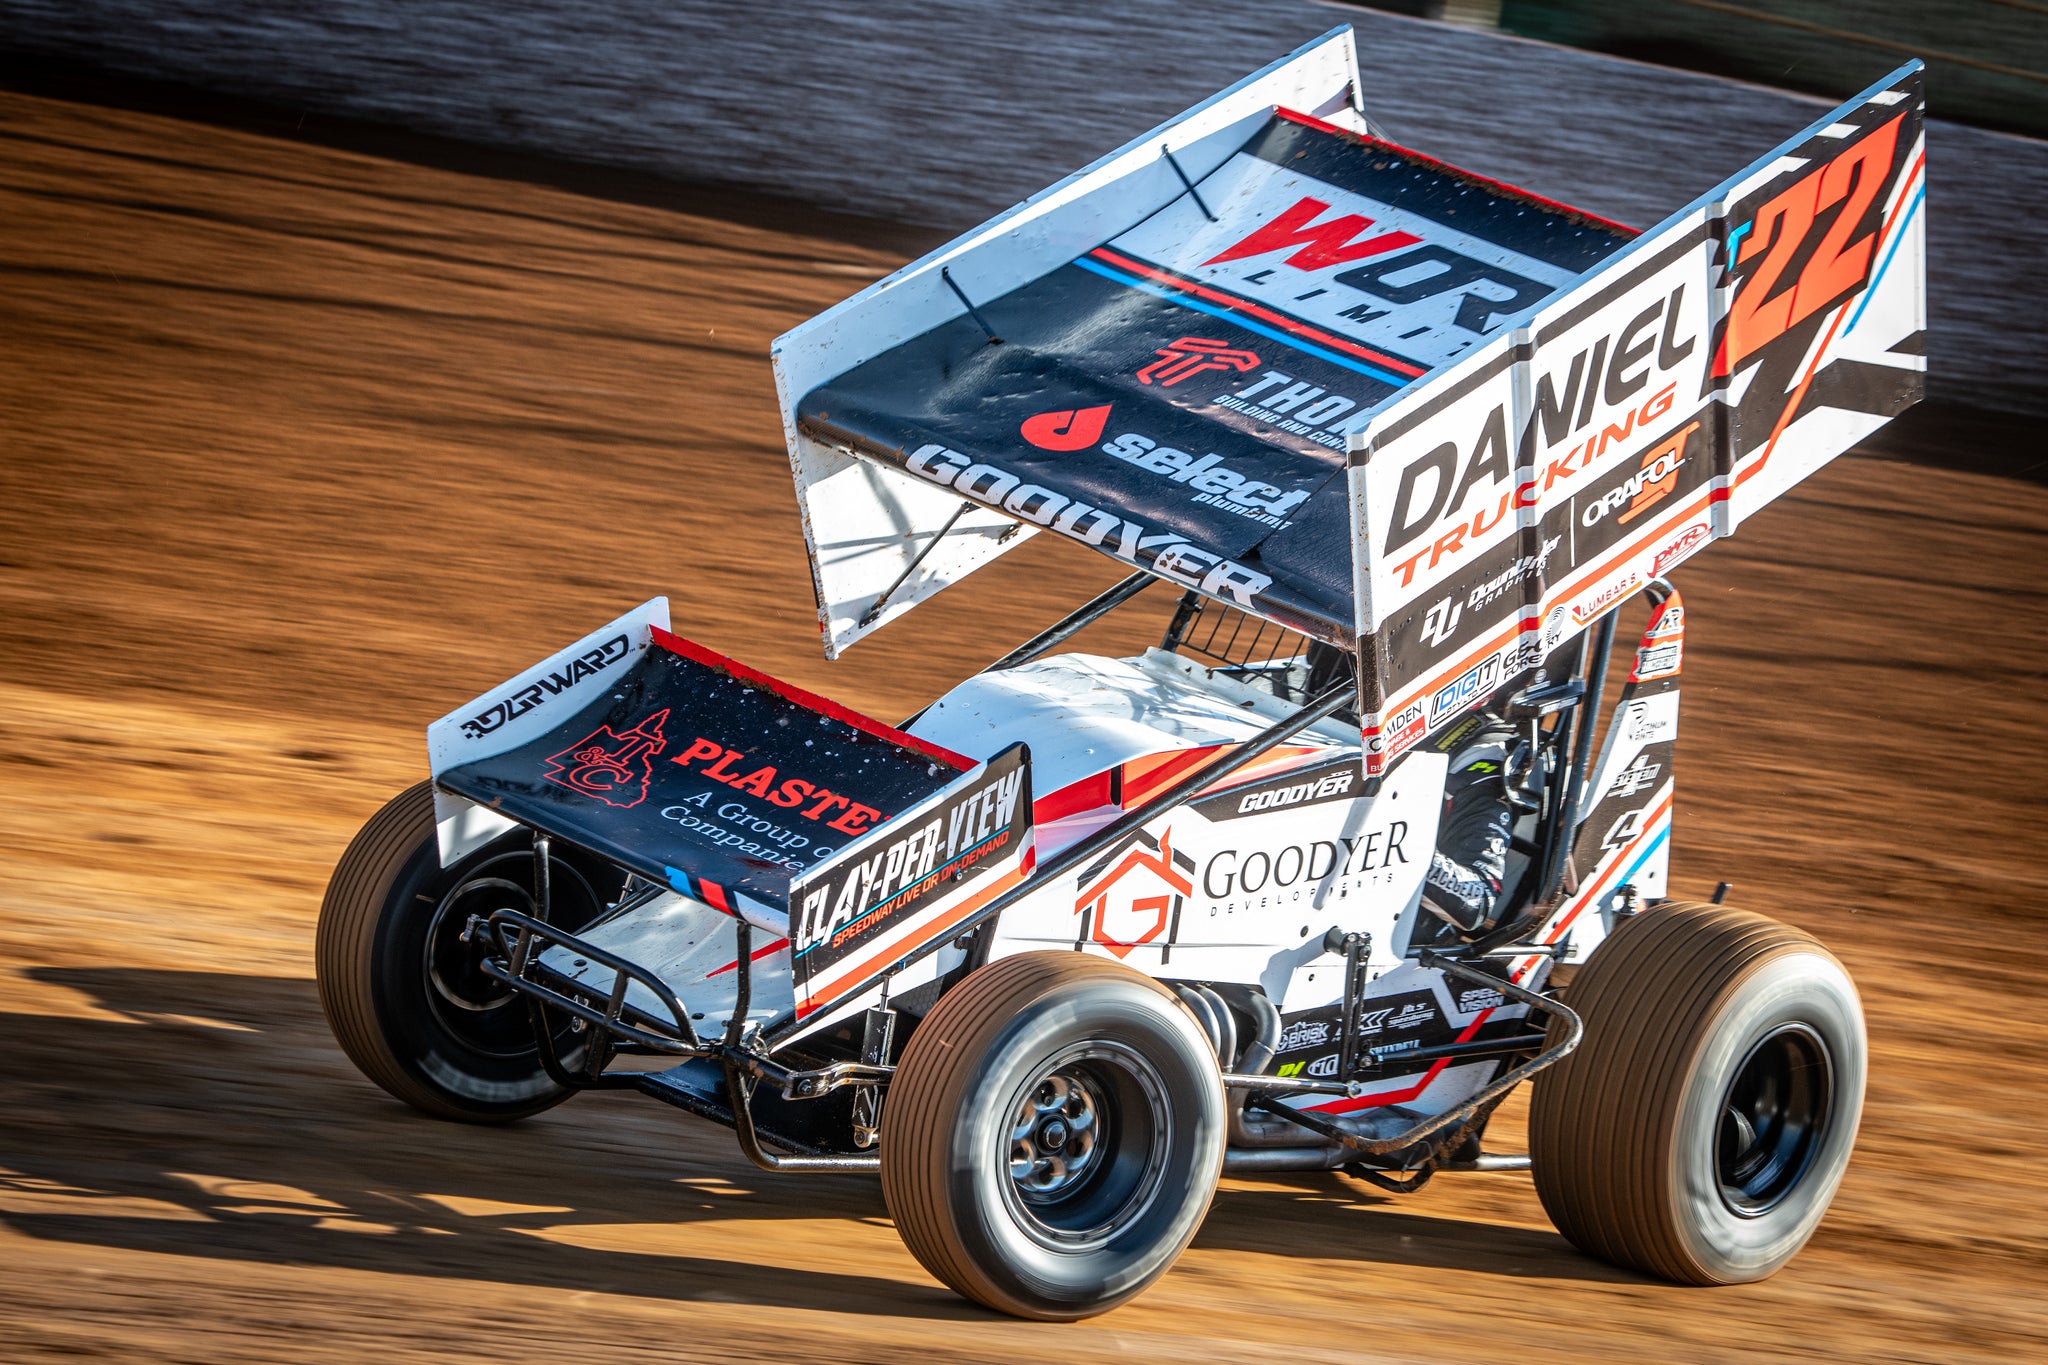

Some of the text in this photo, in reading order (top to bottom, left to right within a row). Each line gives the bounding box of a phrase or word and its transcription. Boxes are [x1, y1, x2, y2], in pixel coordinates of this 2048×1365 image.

[1710, 111, 1907, 379] 22
[1212, 394, 1283, 424] BUILDING
[1276, 419, 1313, 435] AND
[1383, 283, 1697, 559] DANIEL
[1101, 433, 1311, 516] select
[1190, 492, 1294, 531] plumbing
[1393, 381, 1677, 588] TRUCKING
[1582, 448, 1686, 527] ORAFOL
[905, 444, 1274, 610] GOODYER
[670, 737, 893, 837] PLASTE
[684, 791, 712, 808] A
[717, 803, 810, 850] Group
[1238, 775, 1354, 814] GOODYER
[660, 805, 806, 874] Companie
[1203, 821, 1409, 900] GOODYER
[832, 830, 1009, 948] SPEEDWAY LIVE OR ON-DEMAND
[1289, 1024, 1330, 1044] BRISK
